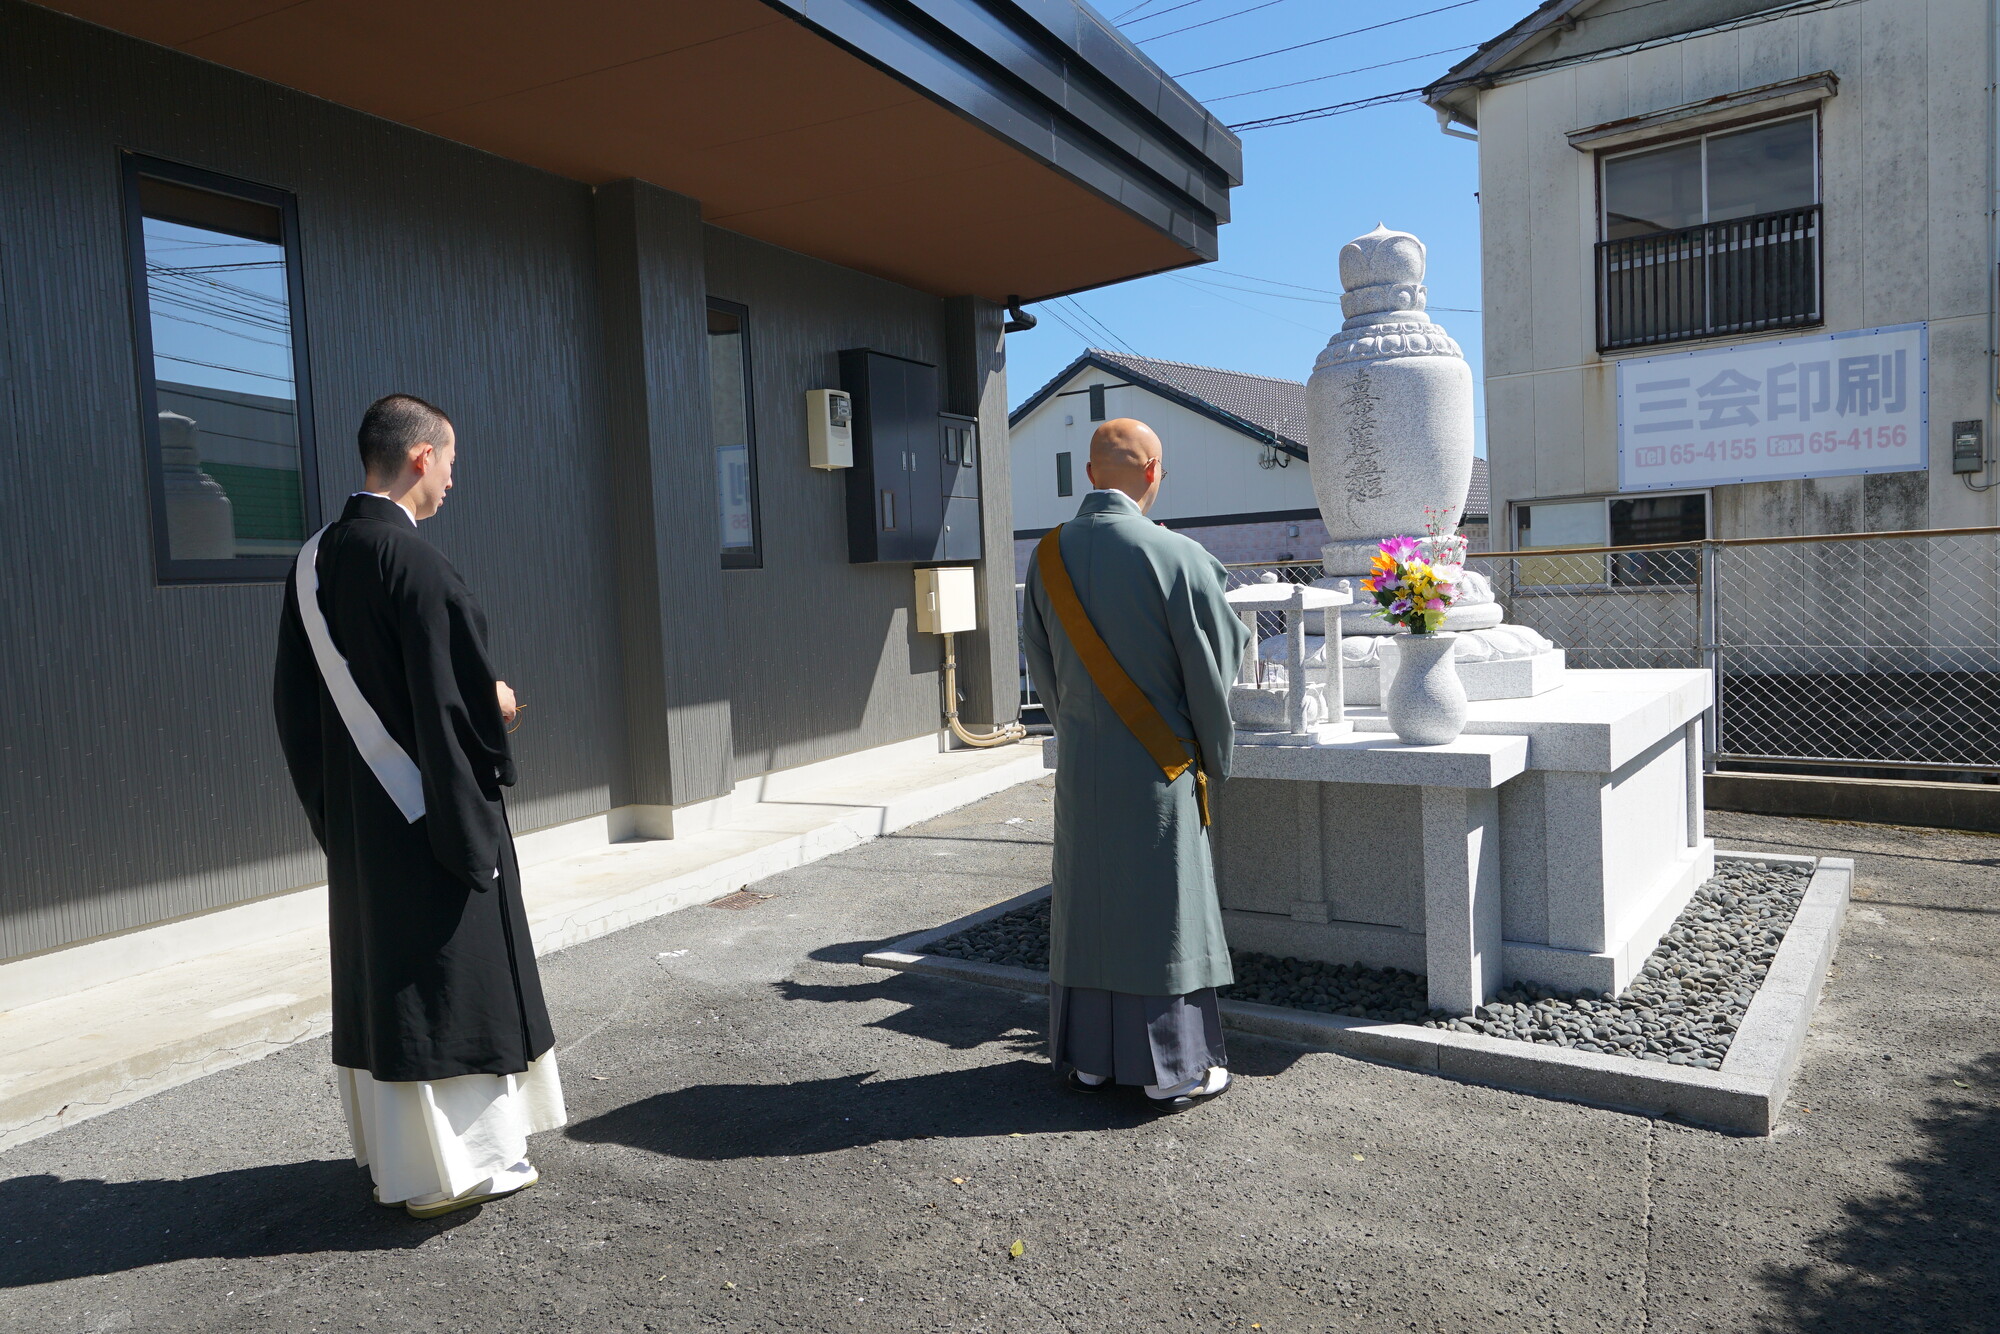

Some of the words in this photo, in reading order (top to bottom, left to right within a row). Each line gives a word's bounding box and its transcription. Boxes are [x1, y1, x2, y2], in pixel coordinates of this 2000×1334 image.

[1633, 349, 1907, 434] 三会印刷
[1638, 447, 1664, 466] Tel
[1670, 438, 1757, 465] 65-4155
[1769, 436, 1802, 456] Fax
[1809, 425, 1907, 454] 65-4156
